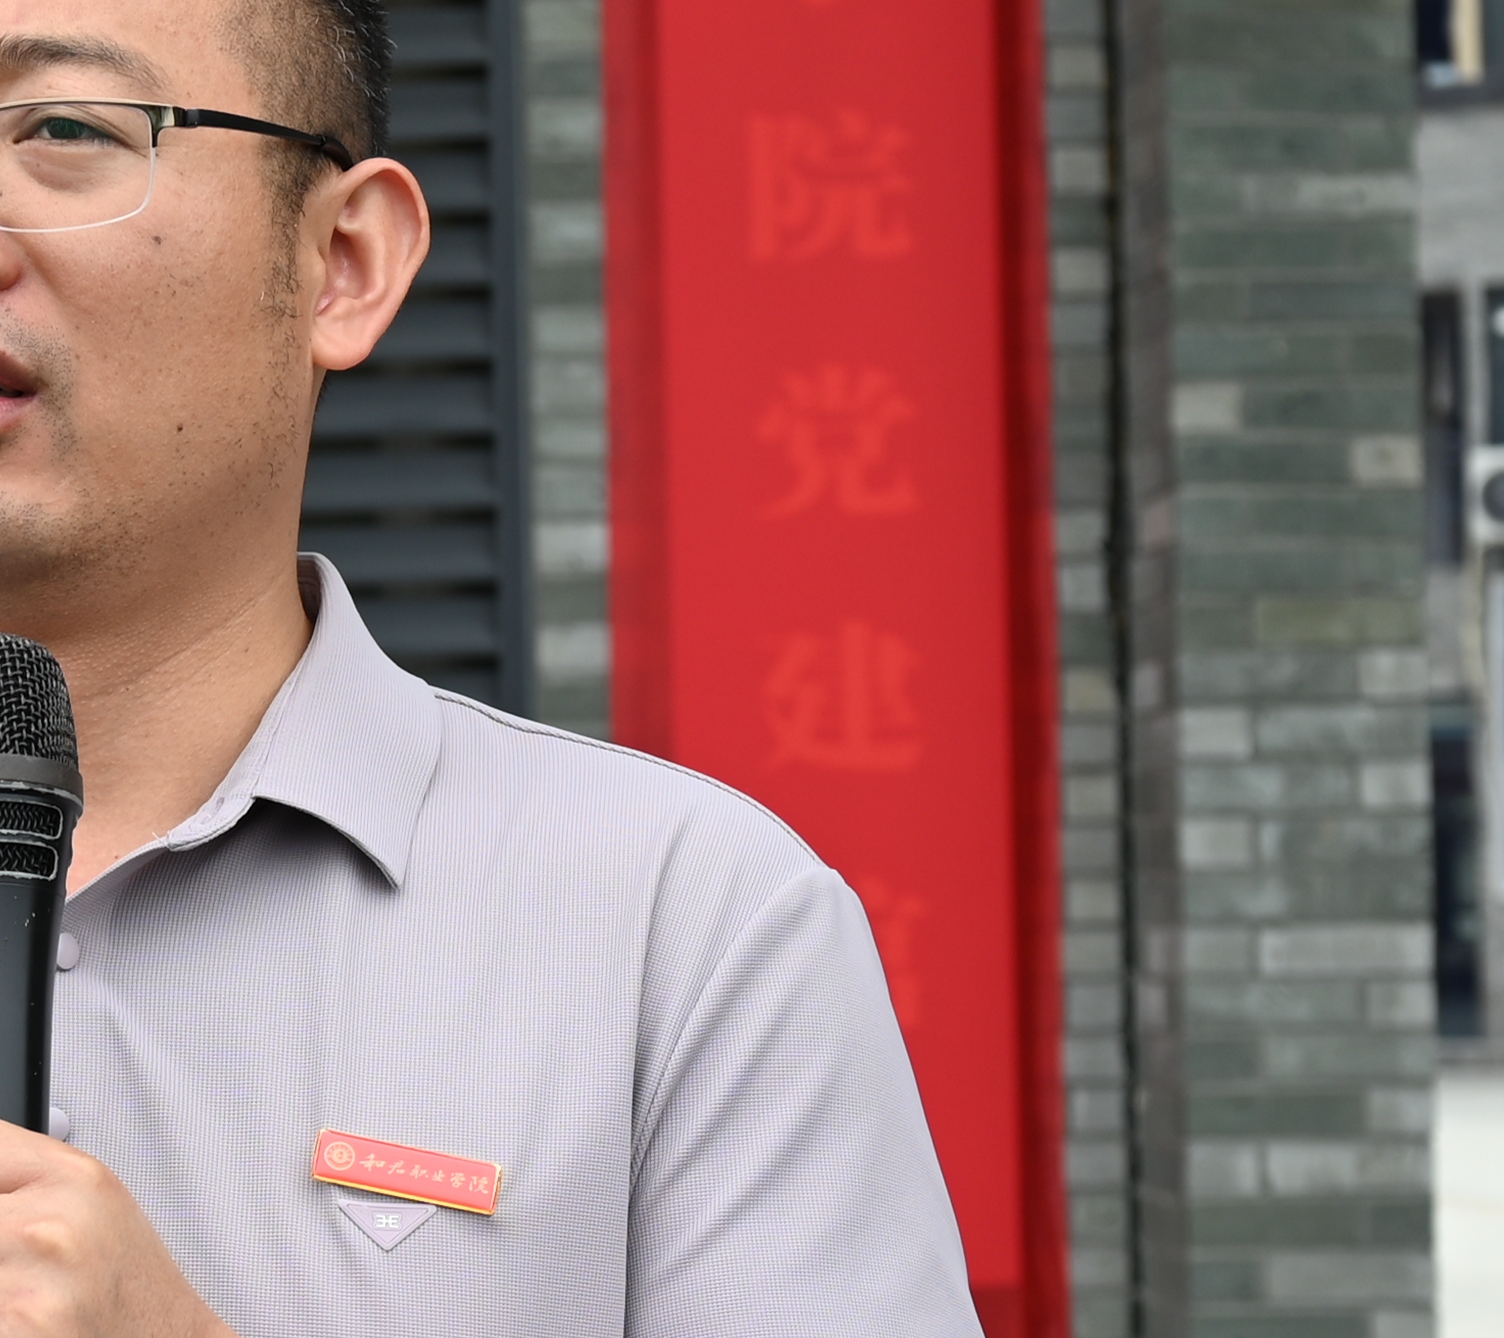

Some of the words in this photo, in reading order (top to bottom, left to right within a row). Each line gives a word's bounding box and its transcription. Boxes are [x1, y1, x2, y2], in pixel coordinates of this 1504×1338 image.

[359, 1153, 489, 1194] 和君职业学院
